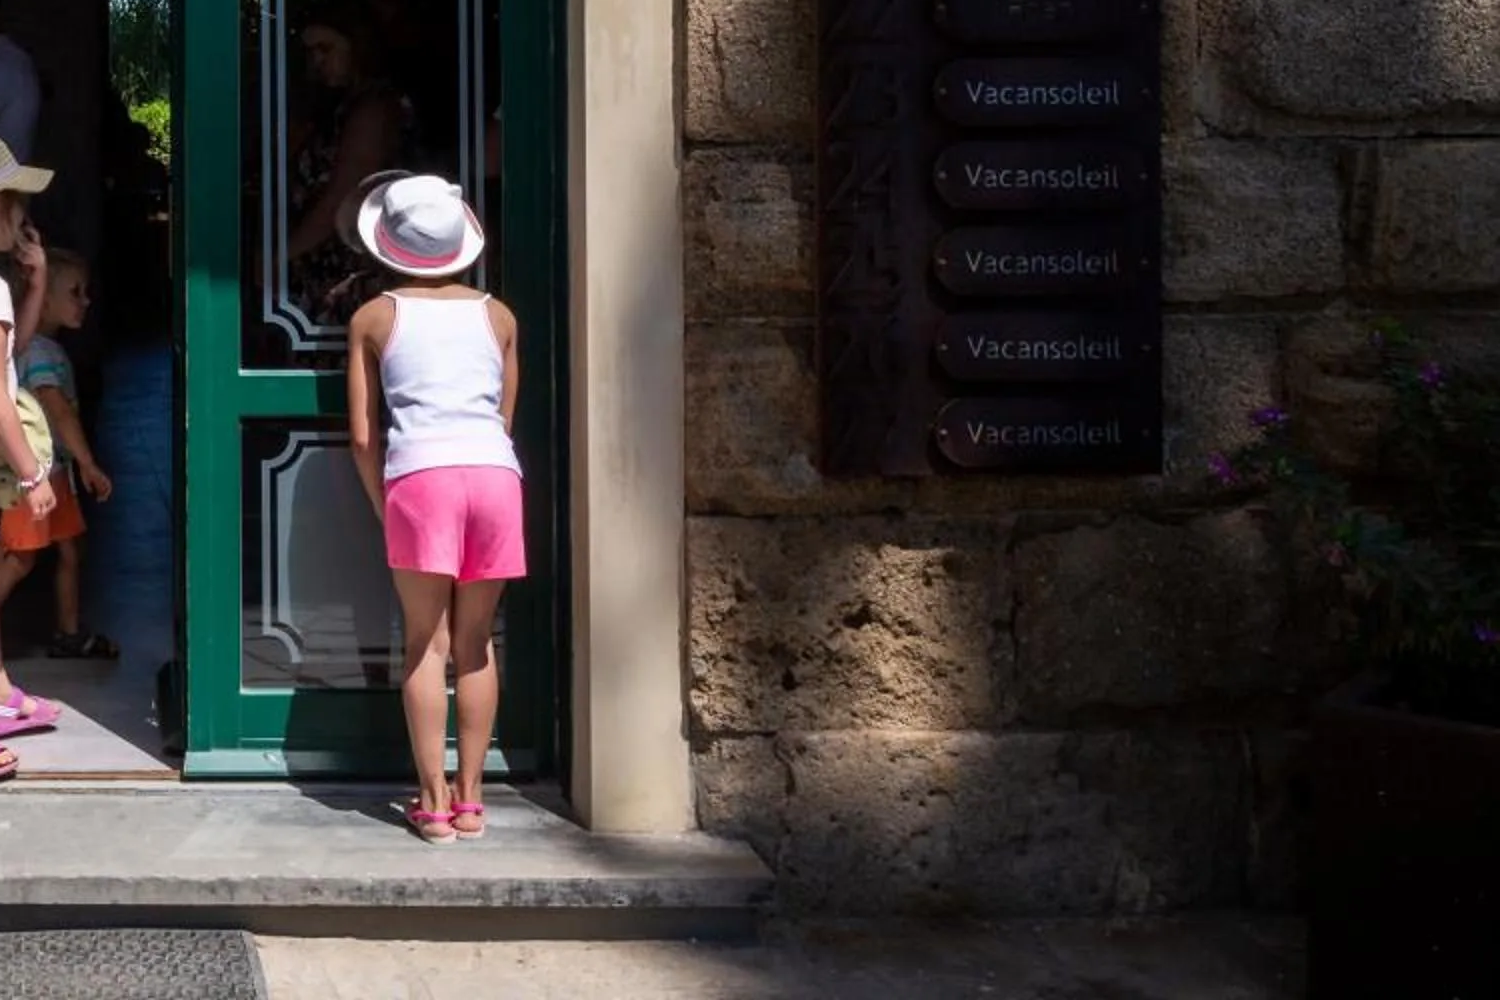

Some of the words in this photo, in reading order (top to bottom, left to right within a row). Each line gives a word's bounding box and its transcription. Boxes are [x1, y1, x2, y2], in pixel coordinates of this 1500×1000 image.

[965, 79, 1121, 107] Vacansoleil
[965, 163, 1120, 190] Vacansoleil
[965, 248, 1120, 275] Vacansoleil
[967, 334, 1122, 361] Vacansoleil
[967, 418, 1122, 446] Vacansoleil
